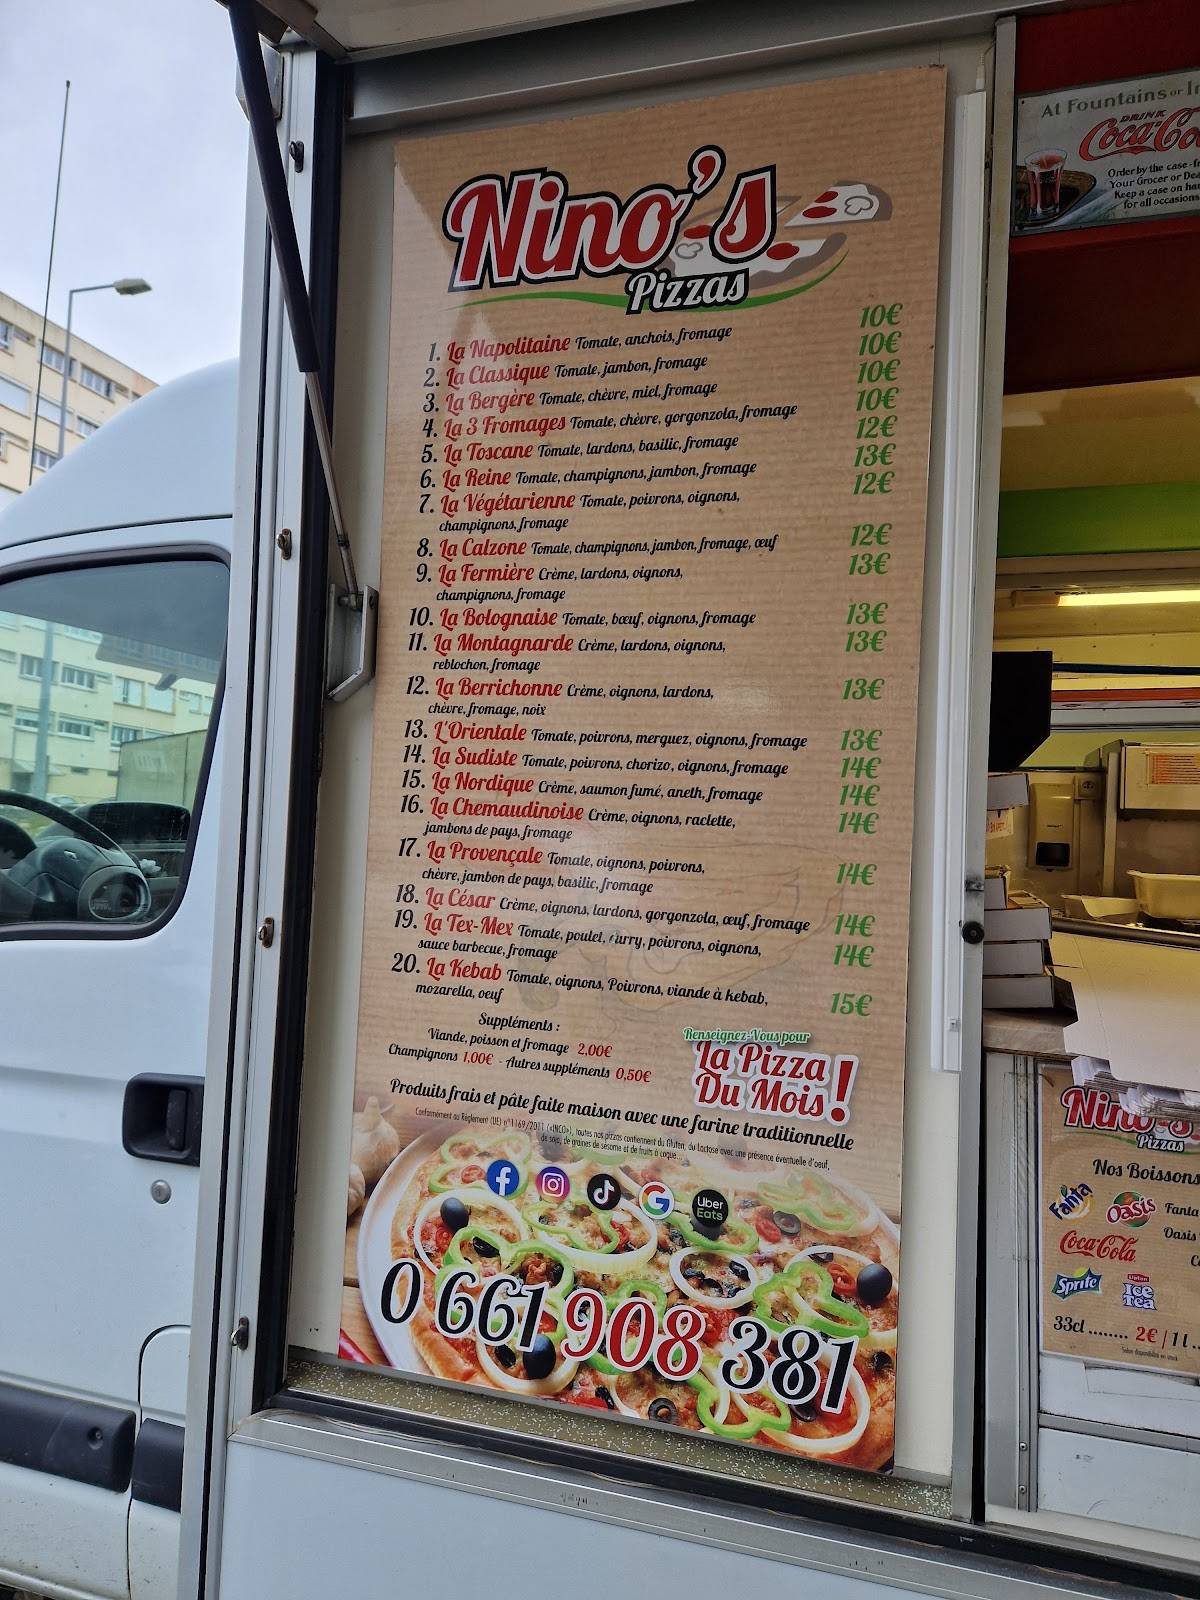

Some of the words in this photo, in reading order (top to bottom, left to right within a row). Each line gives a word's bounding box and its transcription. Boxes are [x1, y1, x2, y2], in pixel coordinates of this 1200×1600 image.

[1042, 105, 1060, 118] At
[1068, 89, 1167, 113] Fountains
[1120, 110, 1167, 123] DRINK
[1108, 168, 1135, 177] Order
[1137, 166, 1148, 176] by
[1149, 164, 1163, 172] the
[1109, 180, 1134, 188] Your
[1137, 176, 1168, 185] Grocer
[1115, 191, 1137, 199] Keep
[1148, 187, 1168, 195] case
[1124, 200, 1138, 208] for
[1140, 198, 1151, 207] all
[442, 144, 776, 292] Nino's
[626, 268, 749, 314] Pizzas
[859, 303, 903, 328] 10€
[428, 343, 441, 361] 1.
[447, 341, 465, 365] La
[470, 335, 571, 361] Napolitaine
[575, 336, 622, 350] Tomate,
[624, 331, 676, 347] anchois,
[675, 327, 732, 345] fromage
[857, 359, 901, 384] 10€
[423, 393, 439, 412] 3.
[446, 393, 464, 416] La
[469, 389, 535, 413] Bergère
[539, 391, 585, 405] Tomate,
[588, 388, 629, 403] chèvre,
[632, 384, 662, 400] miel,
[662, 382, 718, 400] fromage
[855, 415, 898, 439] 12€
[421, 444, 438, 463] 5.
[444, 443, 462, 467] La
[466, 443, 533, 461] Toscane
[538, 444, 583, 458] Tomate,
[586, 441, 636, 456] lardons,
[638, 436, 682, 452] basilic,
[683, 435, 739, 453] fromage
[850, 523, 893, 547] 12€
[416, 538, 433, 557] 8.
[439, 538, 458, 562] La
[462, 538, 528, 556] Calzone
[531, 541, 572, 555] Tomate,
[574, 539, 650, 557] champignons,
[650, 539, 697, 555] jambon,
[697, 537, 751, 553] fromage,
[754, 534, 779, 551] œuf
[409, 607, 434, 626] 10.
[440, 608, 458, 631] La
[463, 608, 558, 631] Bolognaise
[563, 612, 609, 626] Tomate,
[612, 611, 645, 629] bœuf,
[648, 612, 699, 629] oignons,
[698, 611, 757, 627] fromage
[846, 602, 889, 625] 13€
[404, 719, 428, 739] 13.
[434, 721, 527, 745] L'Orientale
[531, 728, 577, 743] Tomate,
[579, 731, 633, 746] poivrons,
[636, 732, 692, 748] merguez,
[695, 733, 748, 749] oignons,
[748, 733, 808, 751] fromage
[840, 729, 883, 751] 13€
[400, 795, 424, 813] 16.
[430, 796, 449, 820] La
[452, 796, 584, 821] Chemaudinoise
[588, 808, 628, 823] Crème,
[631, 812, 682, 827] oignons,
[685, 813, 736, 828] raclette,
[838, 812, 880, 834] 14€
[423, 821, 473, 836] jambons
[475, 824, 488, 836] de
[490, 826, 520, 839] pays,
[520, 824, 573, 842] fromage
[391, 953, 420, 975] 20.
[427, 957, 445, 981] La
[449, 958, 502, 982] Kebab
[507, 969, 552, 987] Tomate,
[555, 975, 603, 991] oignons,
[607, 978, 664, 996] Poivrons,
[667, 984, 711, 999] viande
[713, 986, 722, 1000] à
[725, 989, 769, 1007] kebab,
[416, 981, 475, 999] mozarella,
[478, 988, 504, 1004] oeuf
[830, 992, 873, 1017] 15€
[479, 1012, 553, 1032] Suppléments
[428, 1027, 468, 1043] Viande,
[470, 1035, 509, 1047] poisson
[512, 1038, 521, 1049] et
[521, 1037, 570, 1056] fromage
[577, 1043, 613, 1058] 2,00€
[683, 1027, 781, 1042] Renseignez-Vous
[781, 1031, 811, 1045] pour
[388, 1043, 458, 1062] Champignons
[463, 1051, 494, 1065] 1,00€
[505, 1056, 541, 1071] Autres
[543, 1061, 610, 1078] suppléments
[615, 1066, 652, 1082] 0,50€
[695, 1041, 731, 1078] La
[739, 1042, 827, 1082] Pizza
[695, 1070, 740, 1107] Du
[751, 1078, 825, 1117] Mois
[390, 1078, 446, 1099] Produits
[446, 1085, 480, 1107] frais
[484, 1090, 496, 1106] et
[499, 1093, 530, 1112] pâte
[529, 1095, 564, 1116] faite
[567, 1102, 621, 1121] maison
[624, 1109, 658, 1125] avec
[661, 1115, 689, 1129] une
[689, 1115, 740, 1135] farine
[743, 1122, 855, 1151] traditionnelle
[657, 1138, 665, 1147] du
[688, 1142, 696, 1151] du
[1136, 1134, 1185, 1152] Pizzas
[1093, 1159, 1123, 1176] Nos
[698, 1196, 723, 1209] Uber
[1049, 1182, 1093, 1221] Fanta
[1106, 1196, 1157, 1224] Oasis
[1165, 1203, 1199, 1216] Fanta
[697, 1208, 723, 1220] Eats
[1059, 1230, 1139, 1262] Coca-Cola
[1164, 1227, 1196, 1241] Oasis
[1057, 1276, 1097, 1295] Sprite
[1124, 1283, 1154, 1298] Ice
[1123, 1295, 1155, 1310] Tea
[379, 1257, 425, 1326] 0
[435, 1266, 551, 1352] 661
[560, 1287, 708, 1382] 908
[720, 1314, 860, 1415] 381
[1054, 1316, 1085, 1333] 33cl
[1136, 1327, 1158, 1343] 2€
